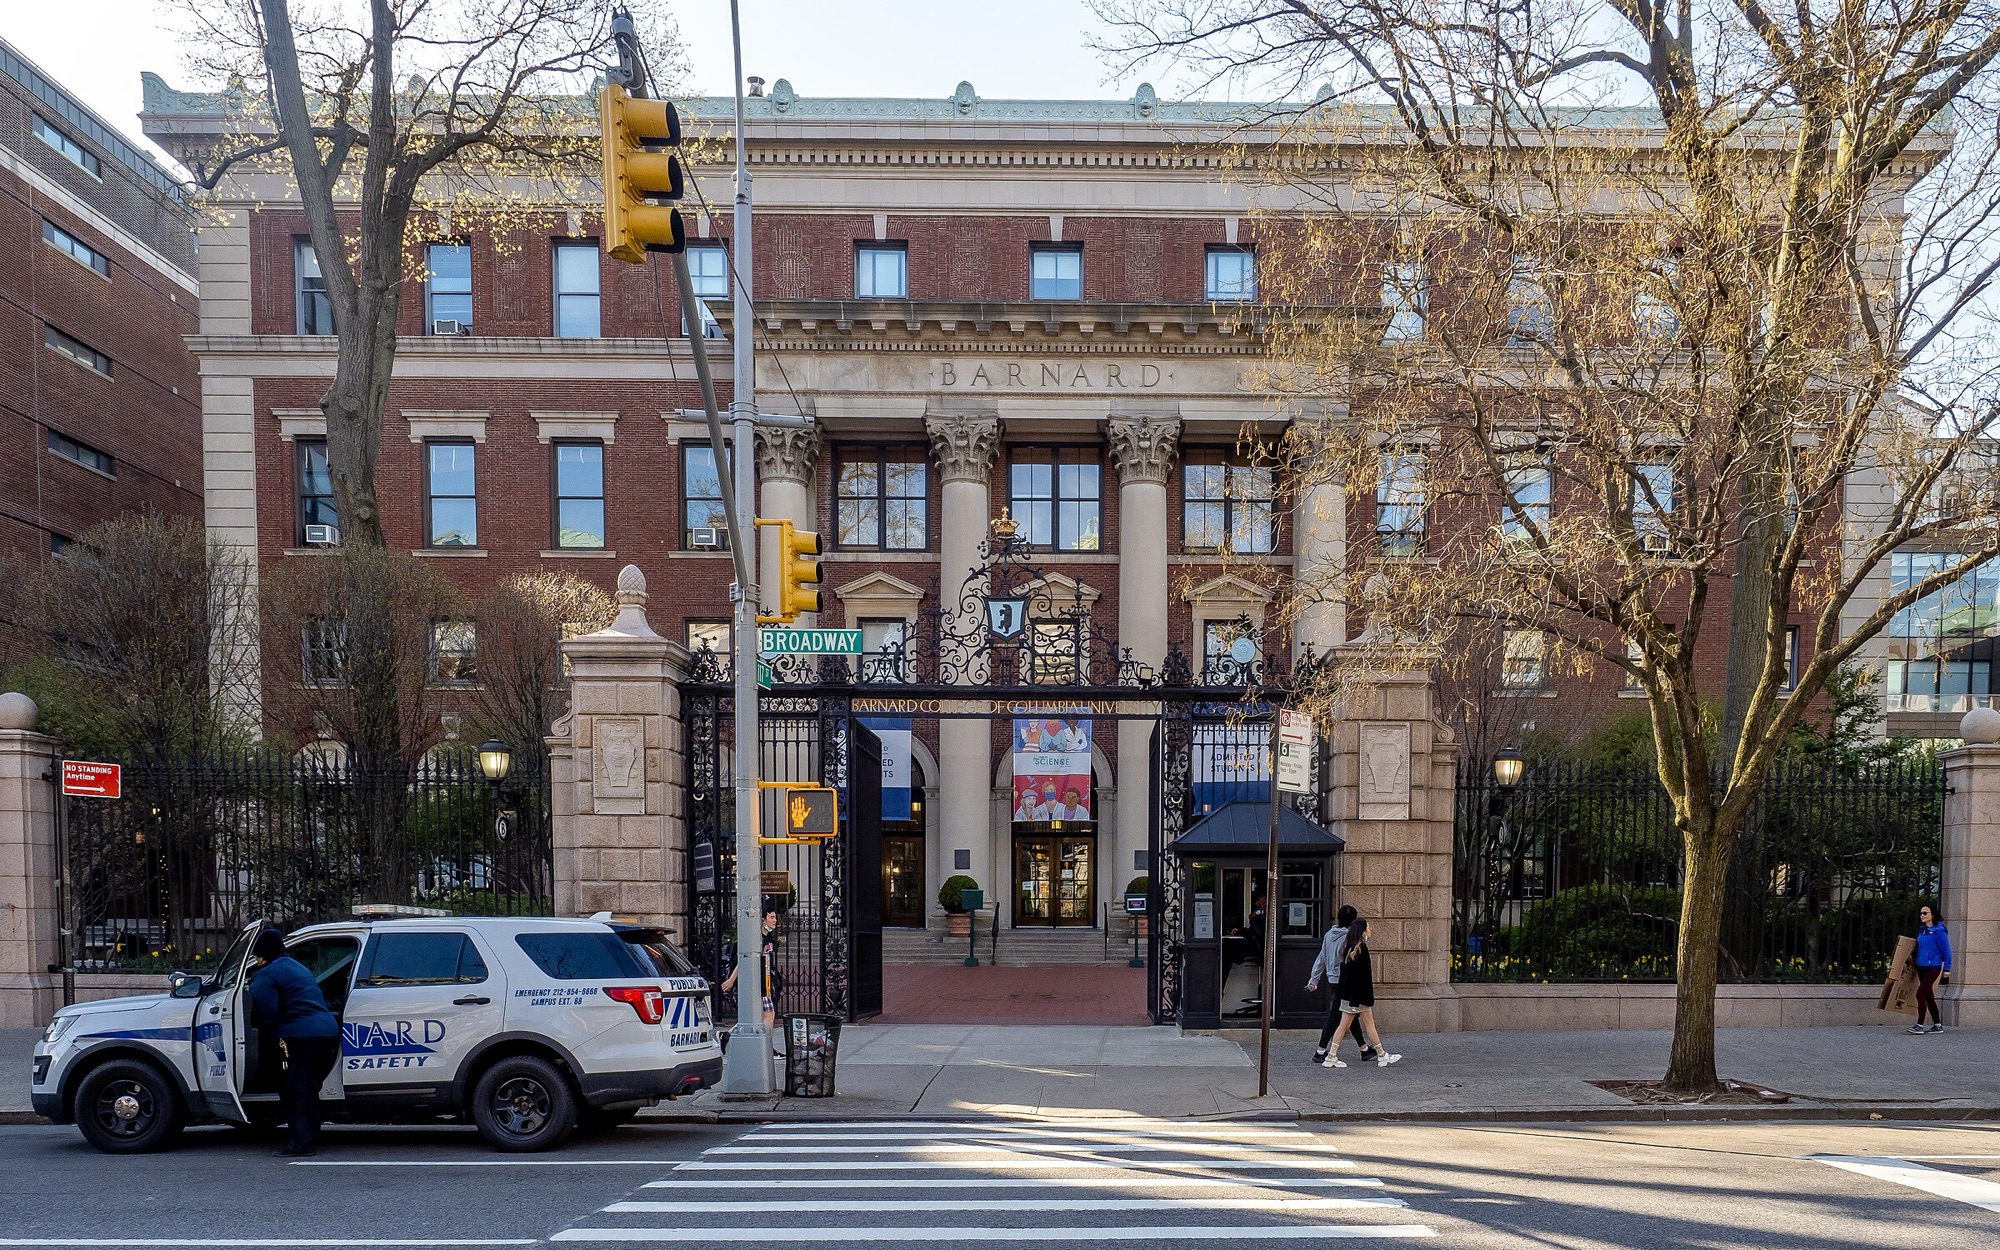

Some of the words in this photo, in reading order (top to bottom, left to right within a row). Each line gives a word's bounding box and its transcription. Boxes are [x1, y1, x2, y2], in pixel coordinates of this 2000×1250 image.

[940, 362, 1161, 388] BARNARD
[763, 631, 858, 652] BROADWAY
[851, 699, 918, 713] BARNARD
[920, 700, 984, 713] COLLEGE
[1006, 700, 1079, 713] COLUMBIA
[1080, 700, 1163, 714] UNIVERSITY
[1281, 743, 1288, 756] 6
[66, 772, 95, 780] Anytime
[78, 765, 112, 774] STANDING
[669, 979, 697, 991] PUBLIC
[515, 989, 551, 997] EMERGENCY
[531, 998, 556, 1006] CAMPUS
[558, 998, 571, 1006] EXT.
[347, 1056, 429, 1070] SAFETY
[210, 1064, 226, 1077] PUBLIC
